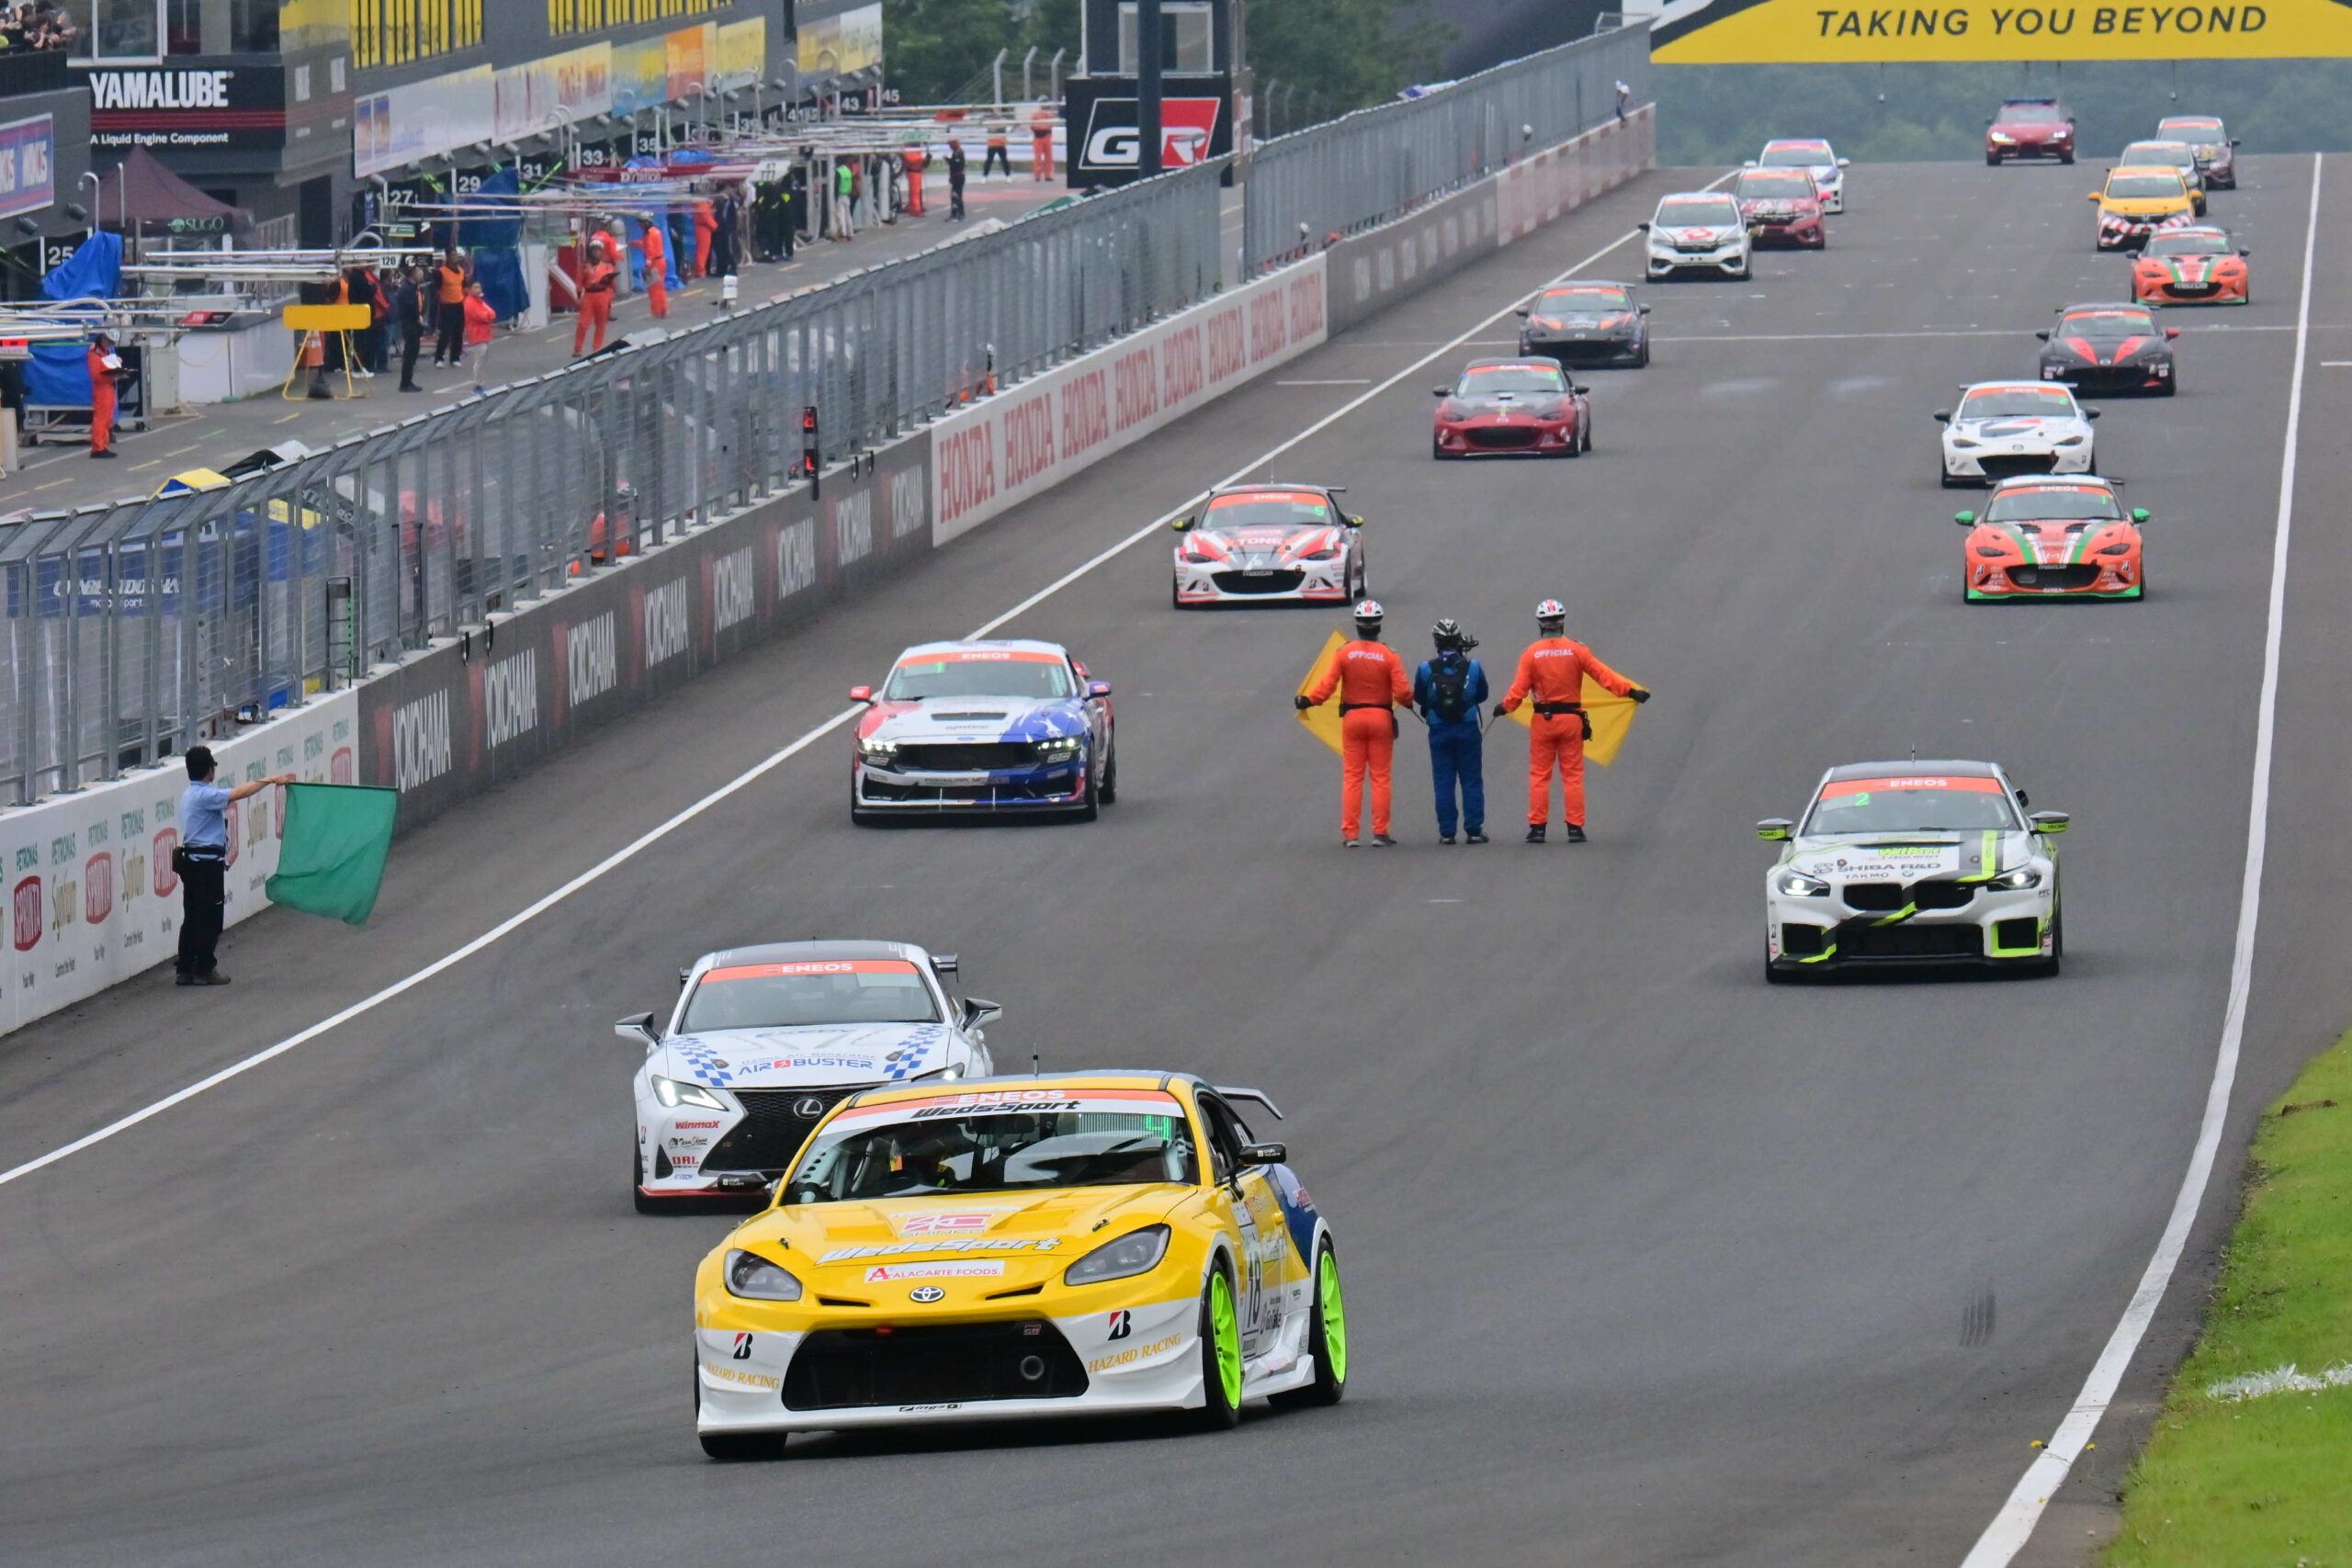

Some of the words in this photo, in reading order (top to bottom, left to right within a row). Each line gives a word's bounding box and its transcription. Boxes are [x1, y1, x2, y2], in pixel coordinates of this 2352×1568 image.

[1816, 8, 1969, 37] TAKING
[1991, 7, 2075, 36] YOU
[2092, 6, 2267, 34] BEYOND
[89, 70, 229, 109] YAMALUBE
[883, 90, 899, 103] 45
[842, 97, 859, 111] 43
[90, 133, 98, 144] A
[101, 133, 131, 146] Liquid
[134, 134, 167, 146] Engine
[170, 132, 229, 146] Component
[582, 151, 604, 165] 33
[522, 164, 543, 179] 31
[458, 176, 481, 192] 29
[390, 190, 413, 205] 27
[185, 217, 224, 230] SUGO
[48, 246, 74, 265] 25
[382, 256, 396, 265] 120
[1114, 344, 1159, 431] HONDA
[1062, 368, 1109, 459] HONDA
[1004, 392, 1056, 490] HONDA
[939, 420, 995, 524] HONDA
[1238, 536, 1283, 545] TONE
[644, 575, 688, 669] YOKOHAMA
[568, 611, 616, 708] YOKOHAMA
[962, 651, 1011, 660] ENEOS
[1347, 650, 1385, 661] OFFICIAL
[1533, 649, 1574, 659] OFFICIAL
[484, 648, 537, 750] YOKOHAMA
[393, 688, 451, 794] YOKOHAMA
[1890, 778, 1948, 788] ENEOS
[1854, 792, 1871, 807] 2
[88, 818, 108, 847] PETRONAS
[121, 807, 144, 840] PETRONAS
[16, 842, 38, 872] PETRONAS
[51, 831, 76, 865] PETRONAS
[86, 859, 111, 918] SPRINTA
[15, 883, 41, 944] SPRINTA
[782, 962, 854, 974] ENEOS
[738, 1061, 772, 1076] AIR
[793, 1057, 873, 1069] BUSTER
[959, 1089, 1067, 1103] ENEOS
[910, 1100, 1081, 1119] WedsSport
[1146, 1115, 1170, 1140] 4
[814, 1237, 1063, 1266] WedsSport
[892, 1269, 953, 1279] ALACARTE
[956, 1268, 1001, 1276] FOODS.
[1088, 1348, 1138, 1374] HAZARD
[1141, 1333, 1182, 1358] RACING
[737, 1371, 780, 1390] RACING
